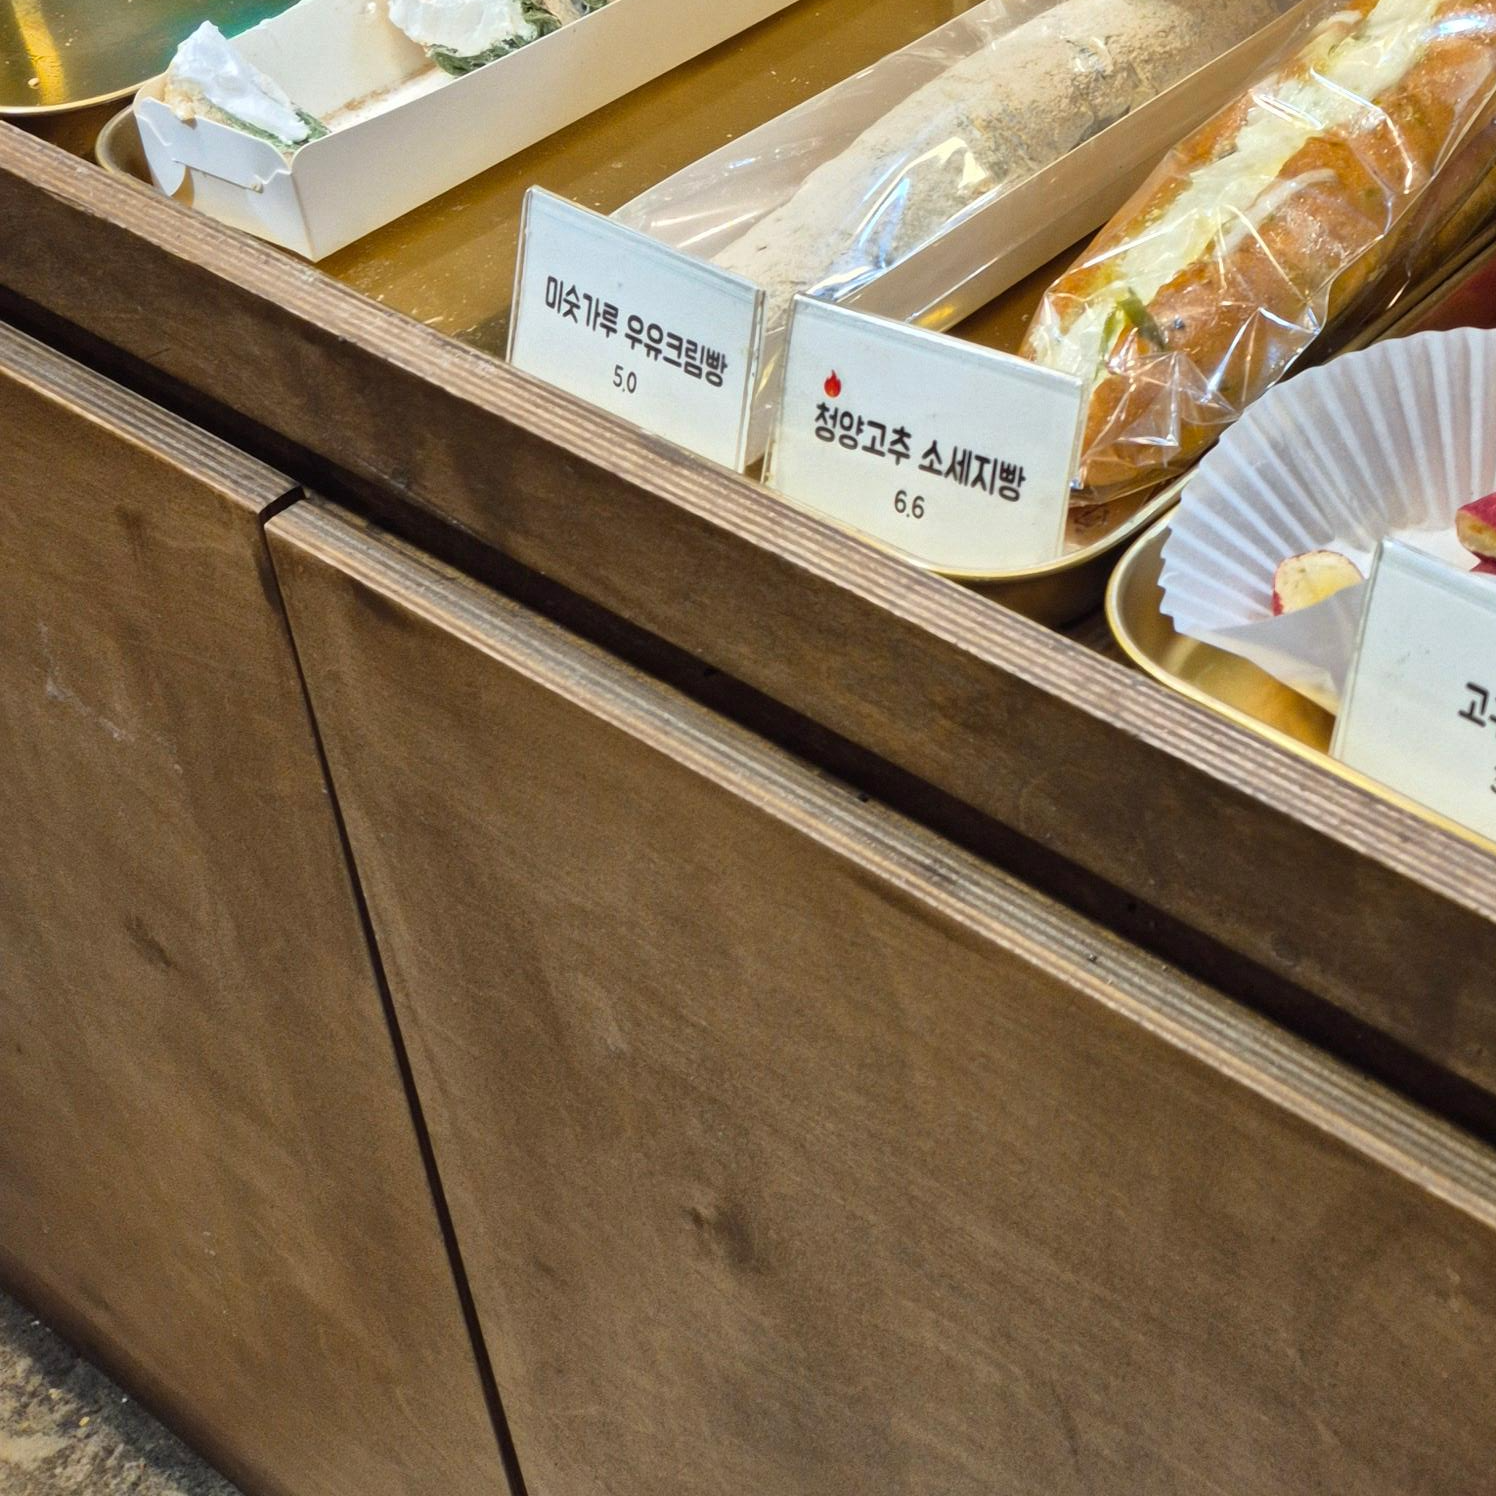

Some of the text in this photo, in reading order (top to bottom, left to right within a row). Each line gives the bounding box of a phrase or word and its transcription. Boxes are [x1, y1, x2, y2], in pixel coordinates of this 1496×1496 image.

[545, 275, 728, 388] 미숫가루 우유크림빵
[612, 364, 638, 394] 5.0
[814, 402, 1026, 502] 청양고추 소세지빵
[894, 489, 925, 519] 6.6
